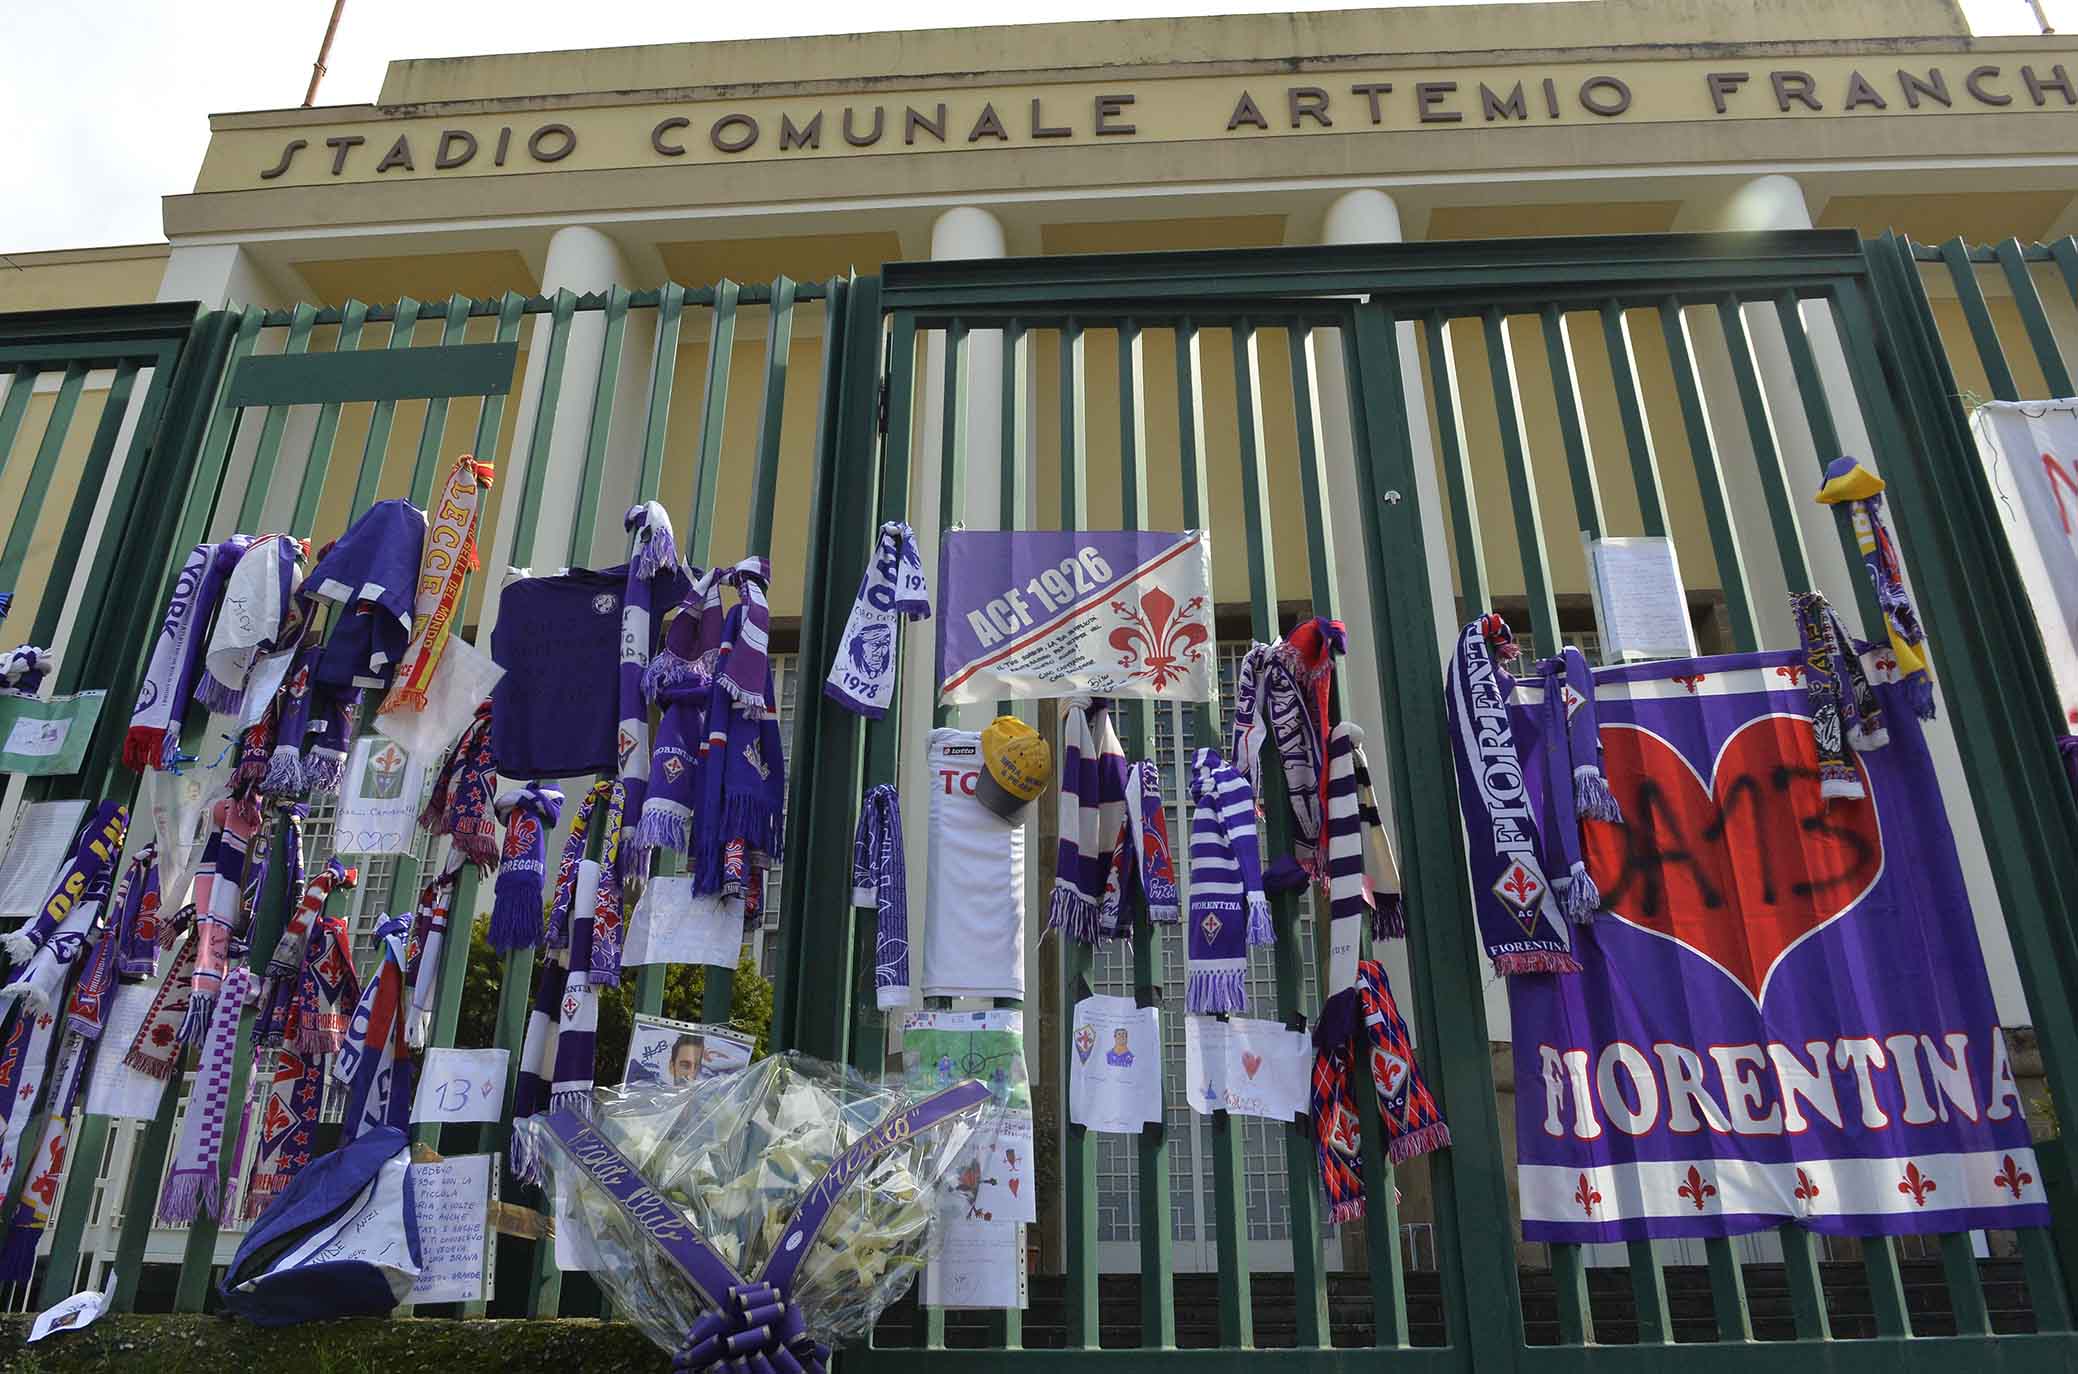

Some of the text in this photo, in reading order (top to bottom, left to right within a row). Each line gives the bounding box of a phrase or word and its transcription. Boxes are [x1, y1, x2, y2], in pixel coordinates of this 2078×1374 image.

[260, 122, 577, 181] STADIO
[650, 94, 1137, 157] COMUNALE
[1226, 75, 1632, 132] ARTEMIO
[420, 479, 476, 596] LECCE
[967, 546, 1113, 649] ACF 1926
[842, 671, 879, 699] 1978
[1489, 939, 1571, 956] FIORENTINA
[434, 1078, 472, 1112] 13
[1538, 1025, 2027, 1140] FIORENTINA
